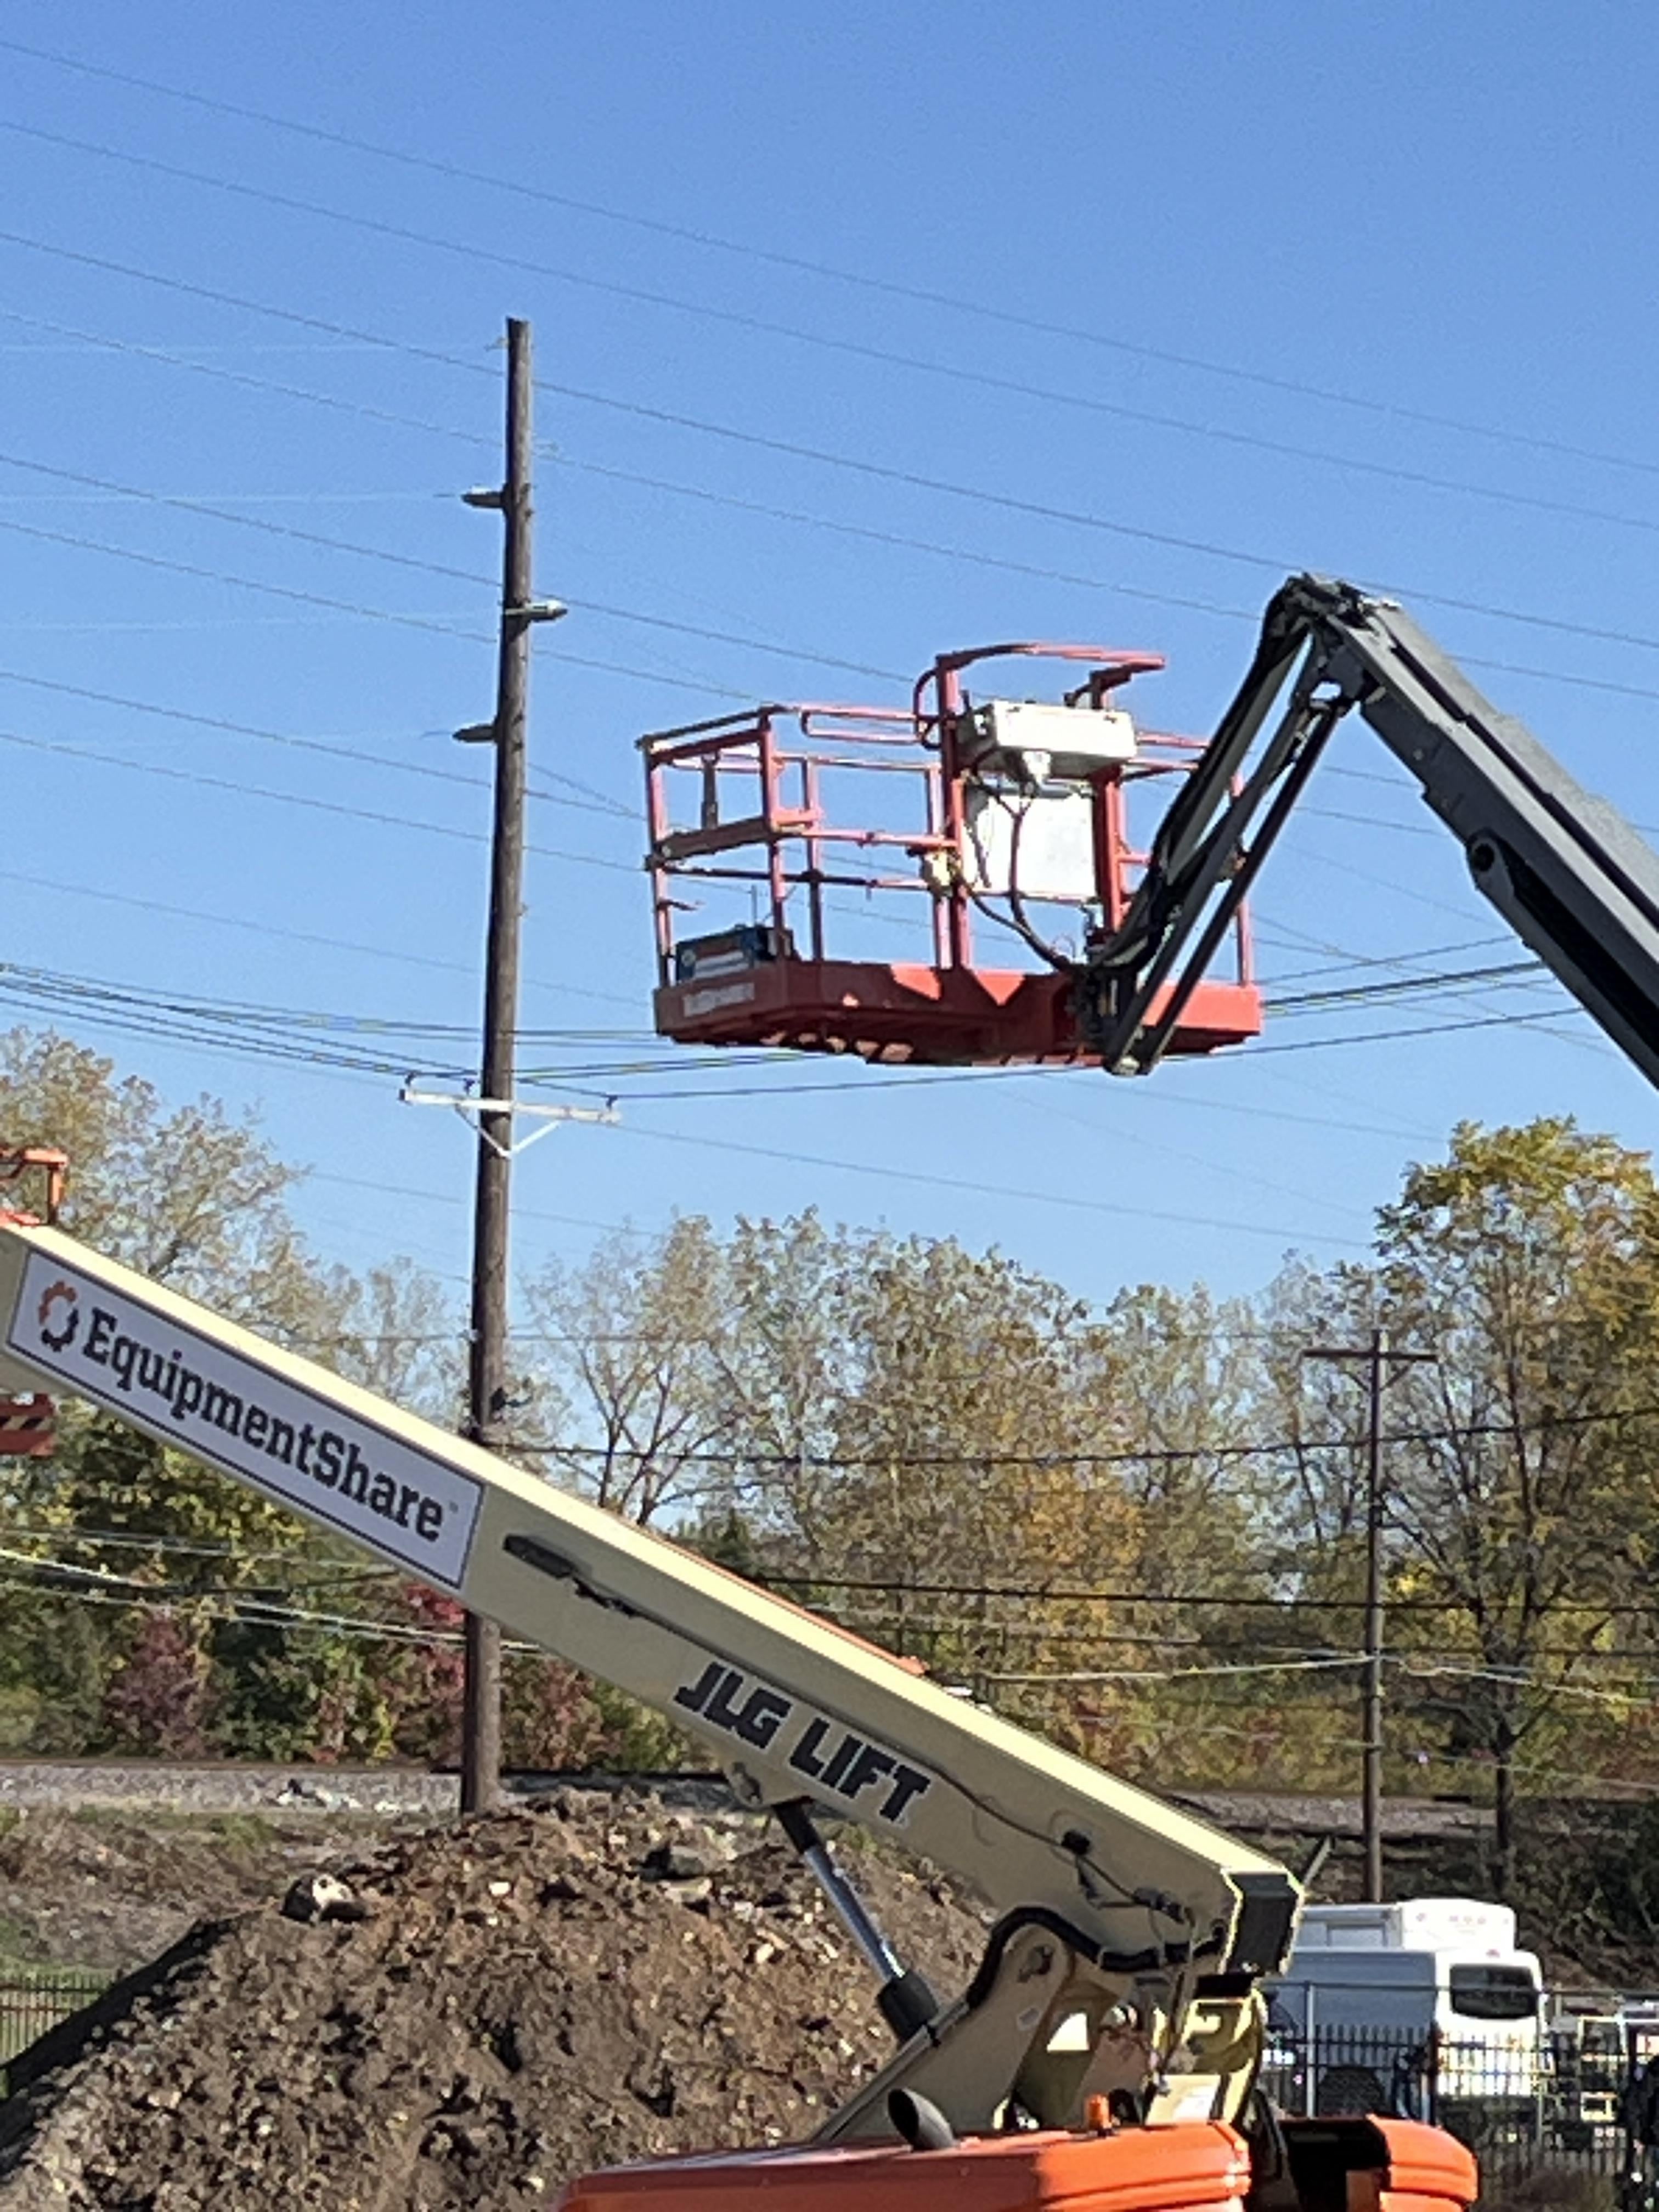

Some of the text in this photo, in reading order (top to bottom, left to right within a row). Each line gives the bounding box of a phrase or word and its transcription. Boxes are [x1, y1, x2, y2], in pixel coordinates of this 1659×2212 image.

[82, 1307, 444, 1542] EquipmentShare
[675, 1662, 930, 1821] JLG LIFT
